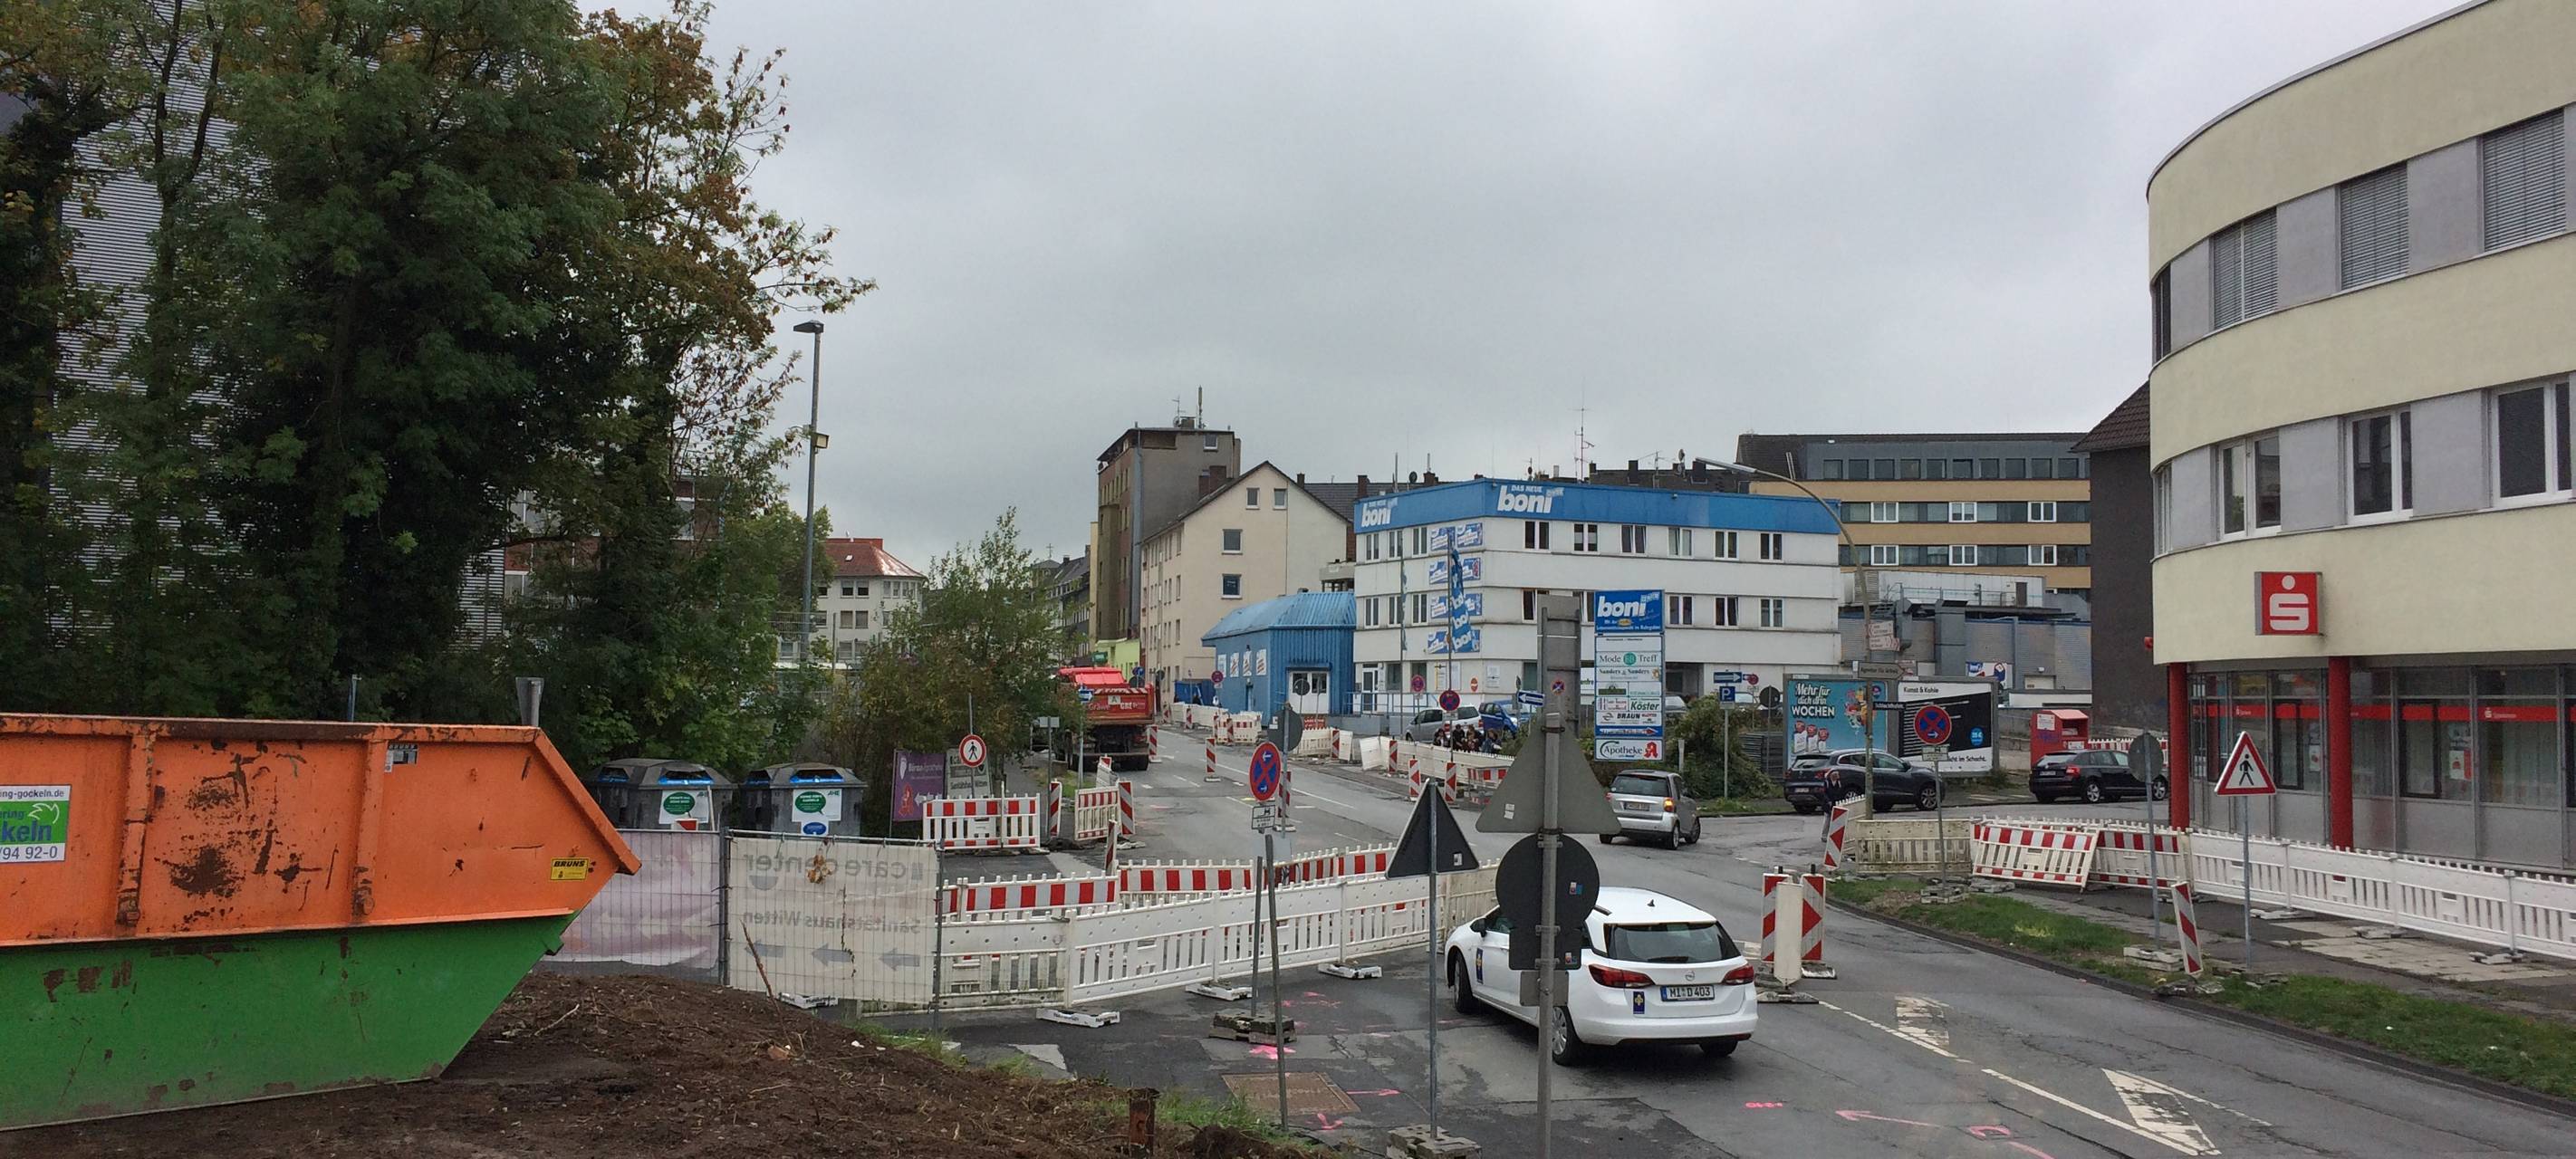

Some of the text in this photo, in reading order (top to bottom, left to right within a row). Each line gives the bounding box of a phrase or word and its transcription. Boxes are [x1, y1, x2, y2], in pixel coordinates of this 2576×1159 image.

[1497, 485, 1552, 513] boni
[1597, 595, 1647, 618] boni
[1600, 655, 1621, 663] Mode
[1639, 654, 1658, 663] Treff
[1796, 683, 1819, 696] Mehr
[1630, 701, 1660, 711] Köster
[1792, 705, 1835, 717] WOCHEN
[1604, 745, 1643, 755] Apotheke
[25, 846, 58, 859] 92-0
[1694, 987, 1711, 997] 403
